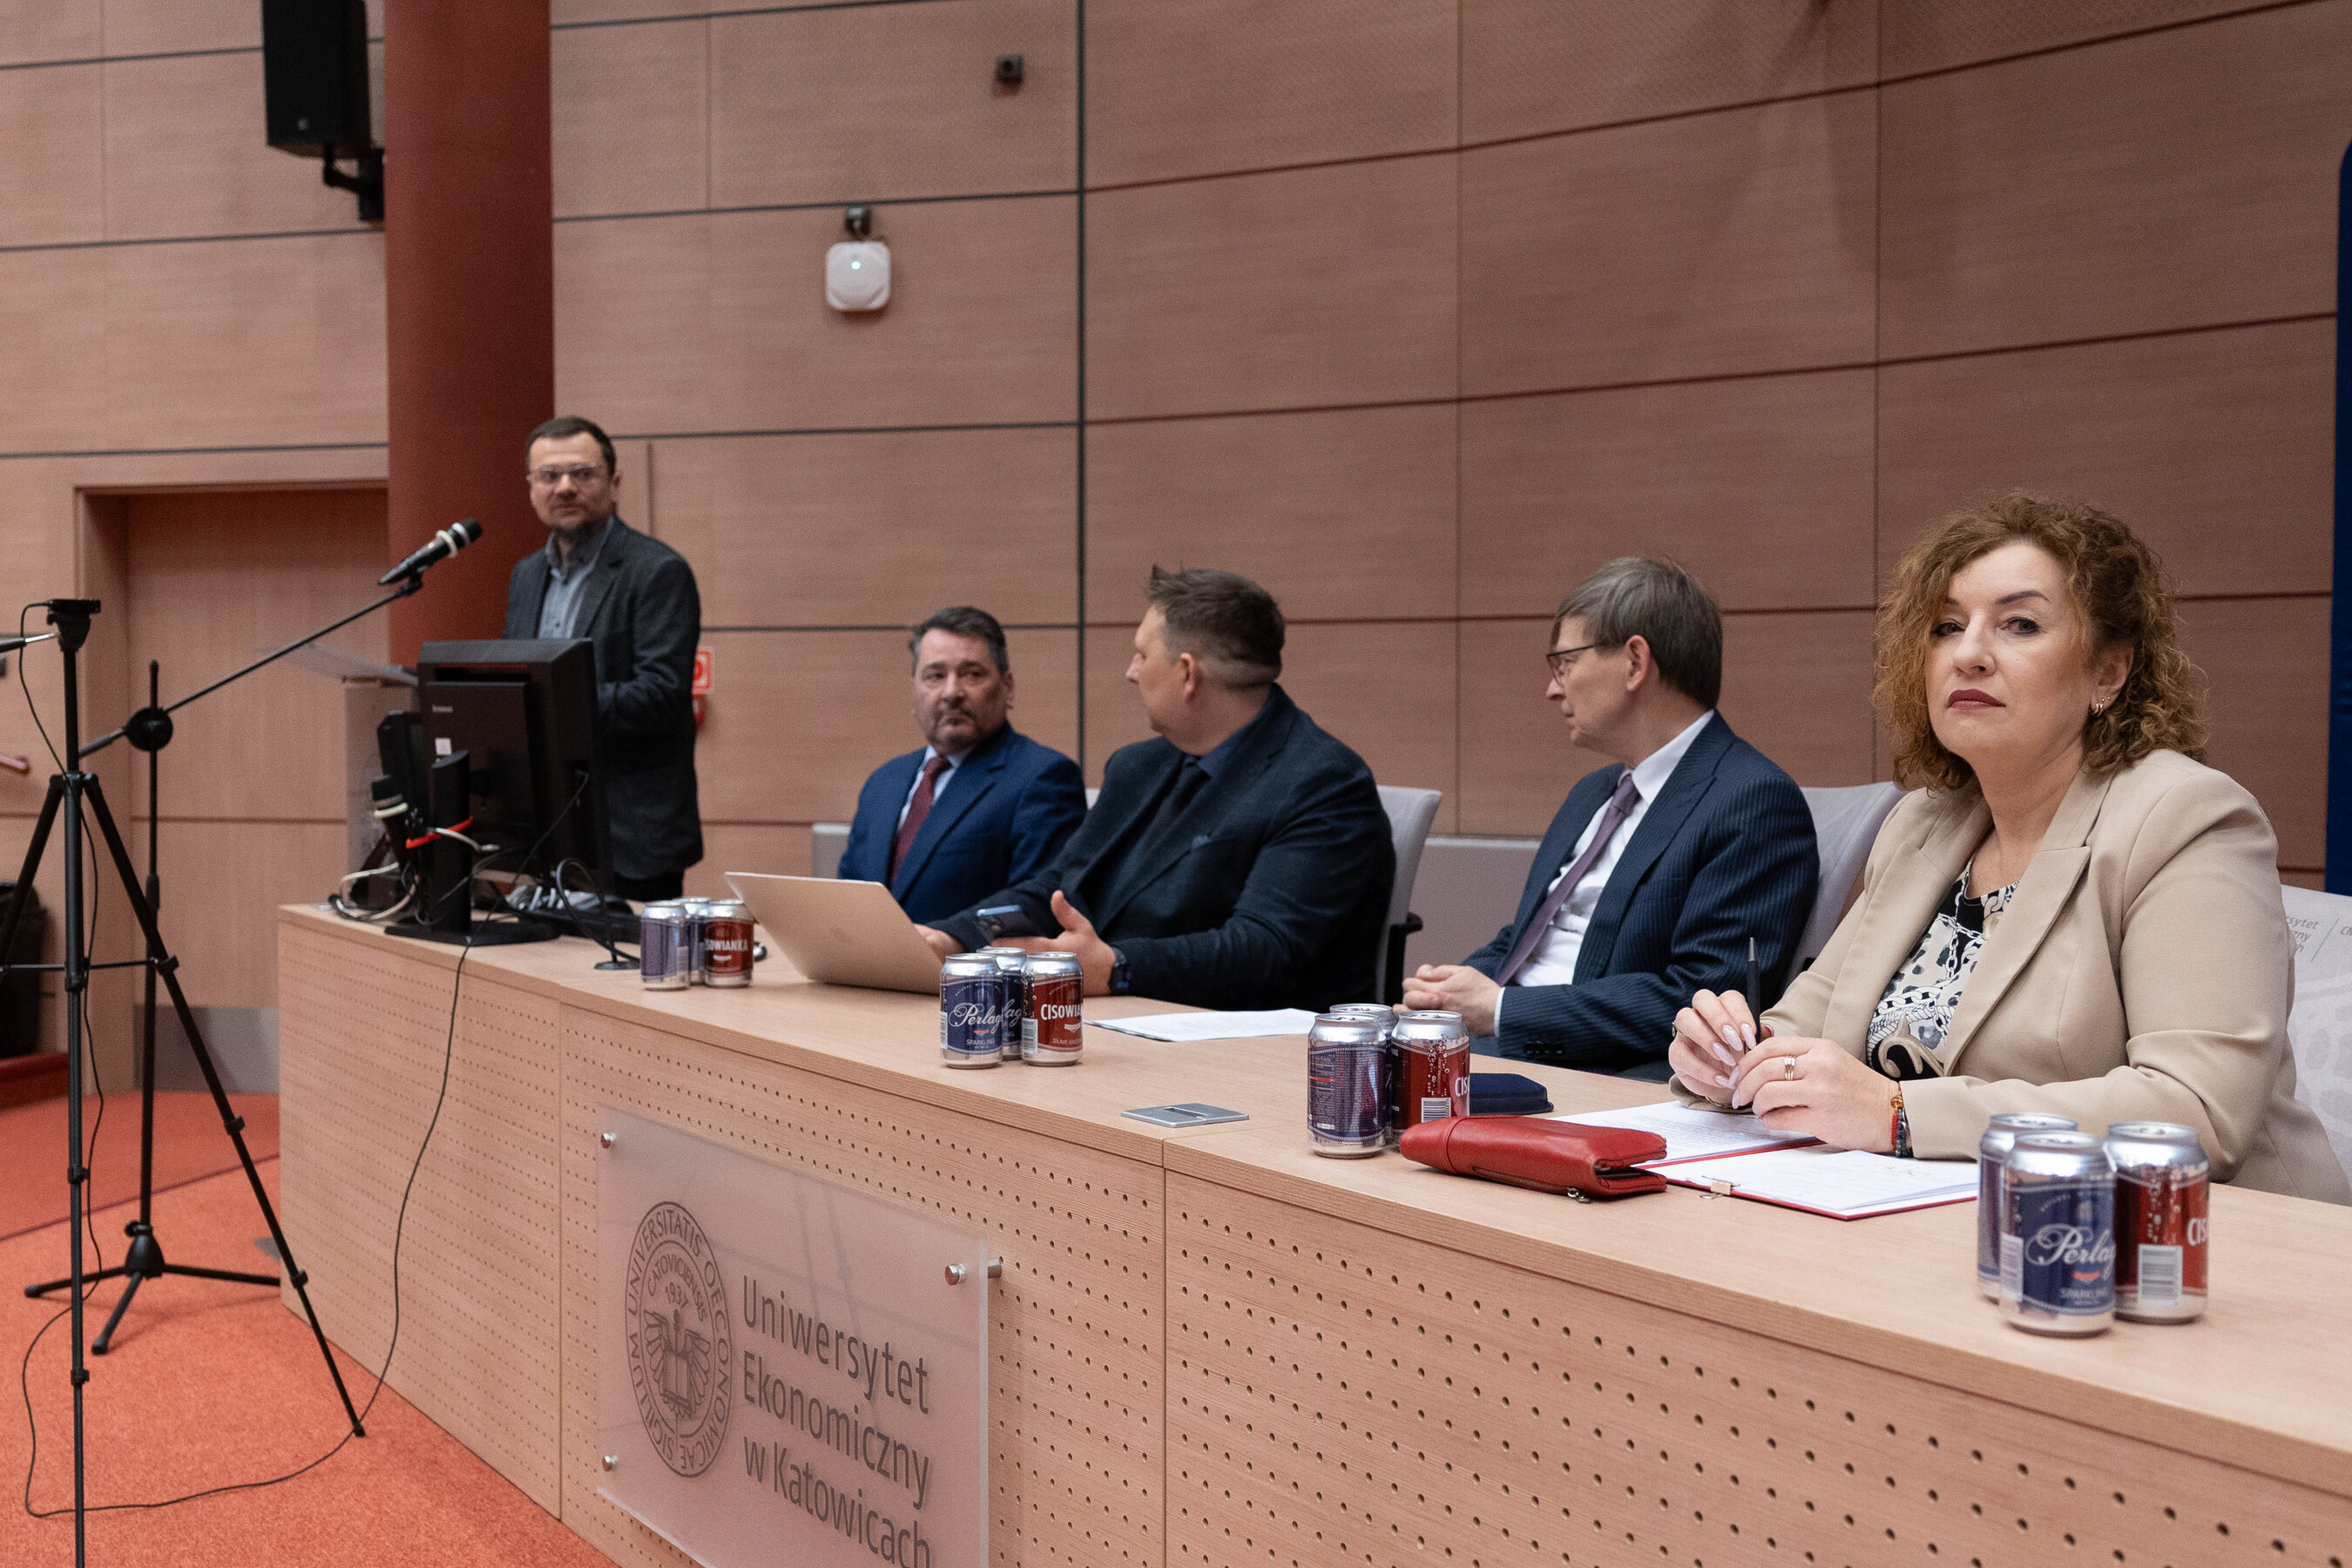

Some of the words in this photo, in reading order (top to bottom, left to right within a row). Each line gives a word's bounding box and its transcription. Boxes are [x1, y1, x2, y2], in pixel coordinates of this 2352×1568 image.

[627, 1209, 703, 1317] UNIVERSITATIS
[679, 1260, 729, 1470] OECONOMICAE
[664, 1281, 690, 1310] 1937
[743, 1274, 929, 1415] Uniwersytet
[743, 1349, 930, 1511] Ekonomiczny
[743, 1436, 766, 1484] w
[773, 1441, 931, 1568] Katowicach
